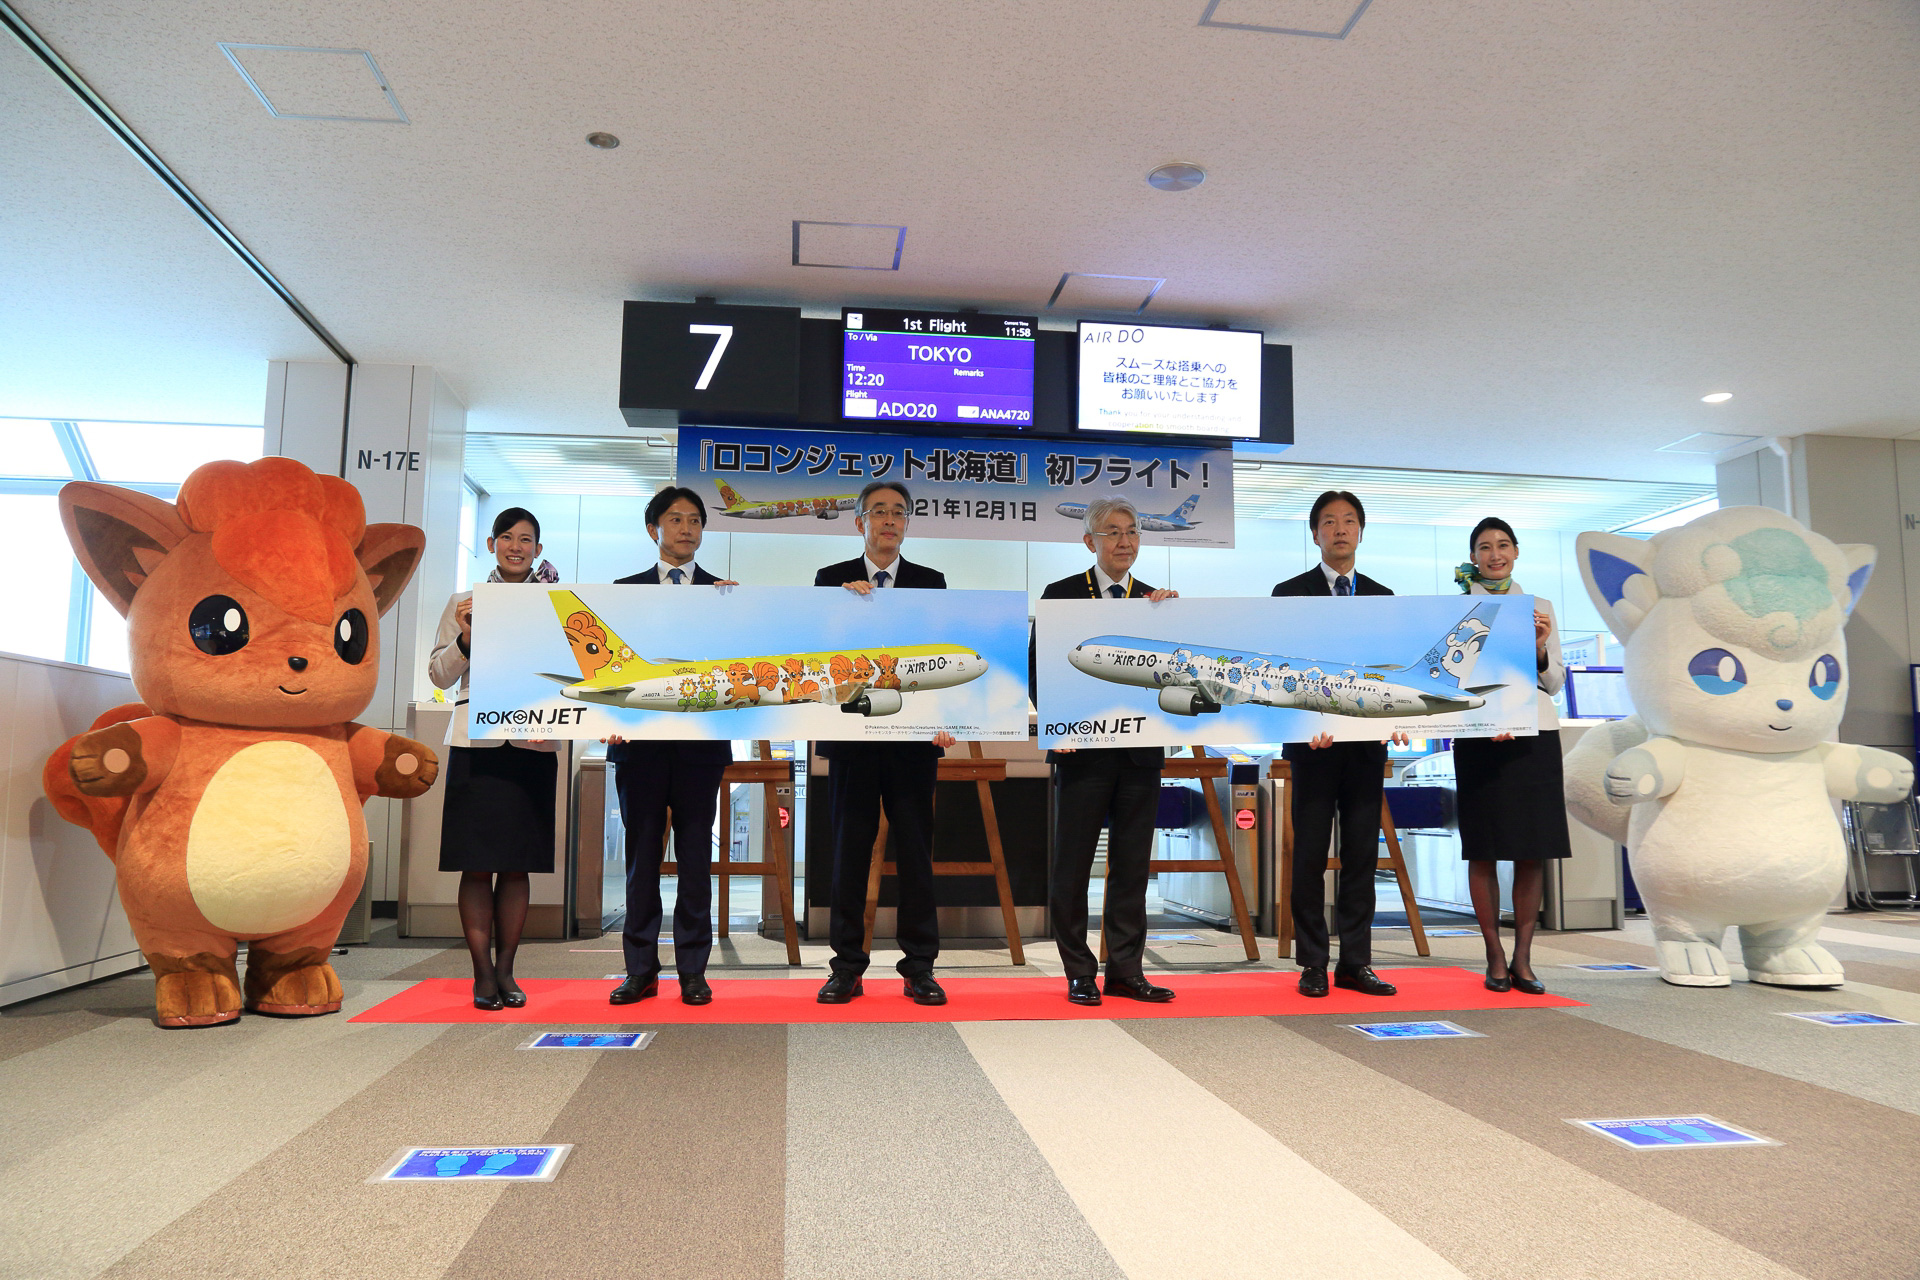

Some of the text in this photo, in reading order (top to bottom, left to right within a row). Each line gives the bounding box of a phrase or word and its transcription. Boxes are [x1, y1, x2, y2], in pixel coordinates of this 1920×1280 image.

[903, 318, 967, 333] 1st Flight
[1005, 327, 1031, 337] 11:58
[848, 333, 858, 341] To
[865, 334, 878, 342] Via
[1083, 328, 1144, 343] AIR DO
[689, 324, 733, 390] 7
[908, 345, 972, 363] TOKYO
[847, 364, 866, 372] Time
[954, 368, 984, 377] Remarks
[1116, 357, 1227, 373] スムーズな搭乗への
[847, 373, 885, 387] 12:20
[1103, 372, 1238, 390] 皆様のご理解とご協力を
[846, 390, 868, 399] Flight
[1121, 388, 1220, 404] お願いいたします
[878, 402, 937, 418] ADO20
[980, 409, 1030, 421] ANA4720
[1099, 408, 1121, 416] Thank
[1108, 421, 1154, 430] cooperation
[1166, 423, 1195, 431] smooth
[358, 450, 420, 471] N-17E
[700, 438, 1028, 486] 『ロコンジェット北海道』
[906, 657, 946, 675] AIR DO
[1114, 654, 1157, 667] AIR DO
[476, 706, 587, 725] ROKON JET
[1045, 716, 1147, 735] ROKON JET
